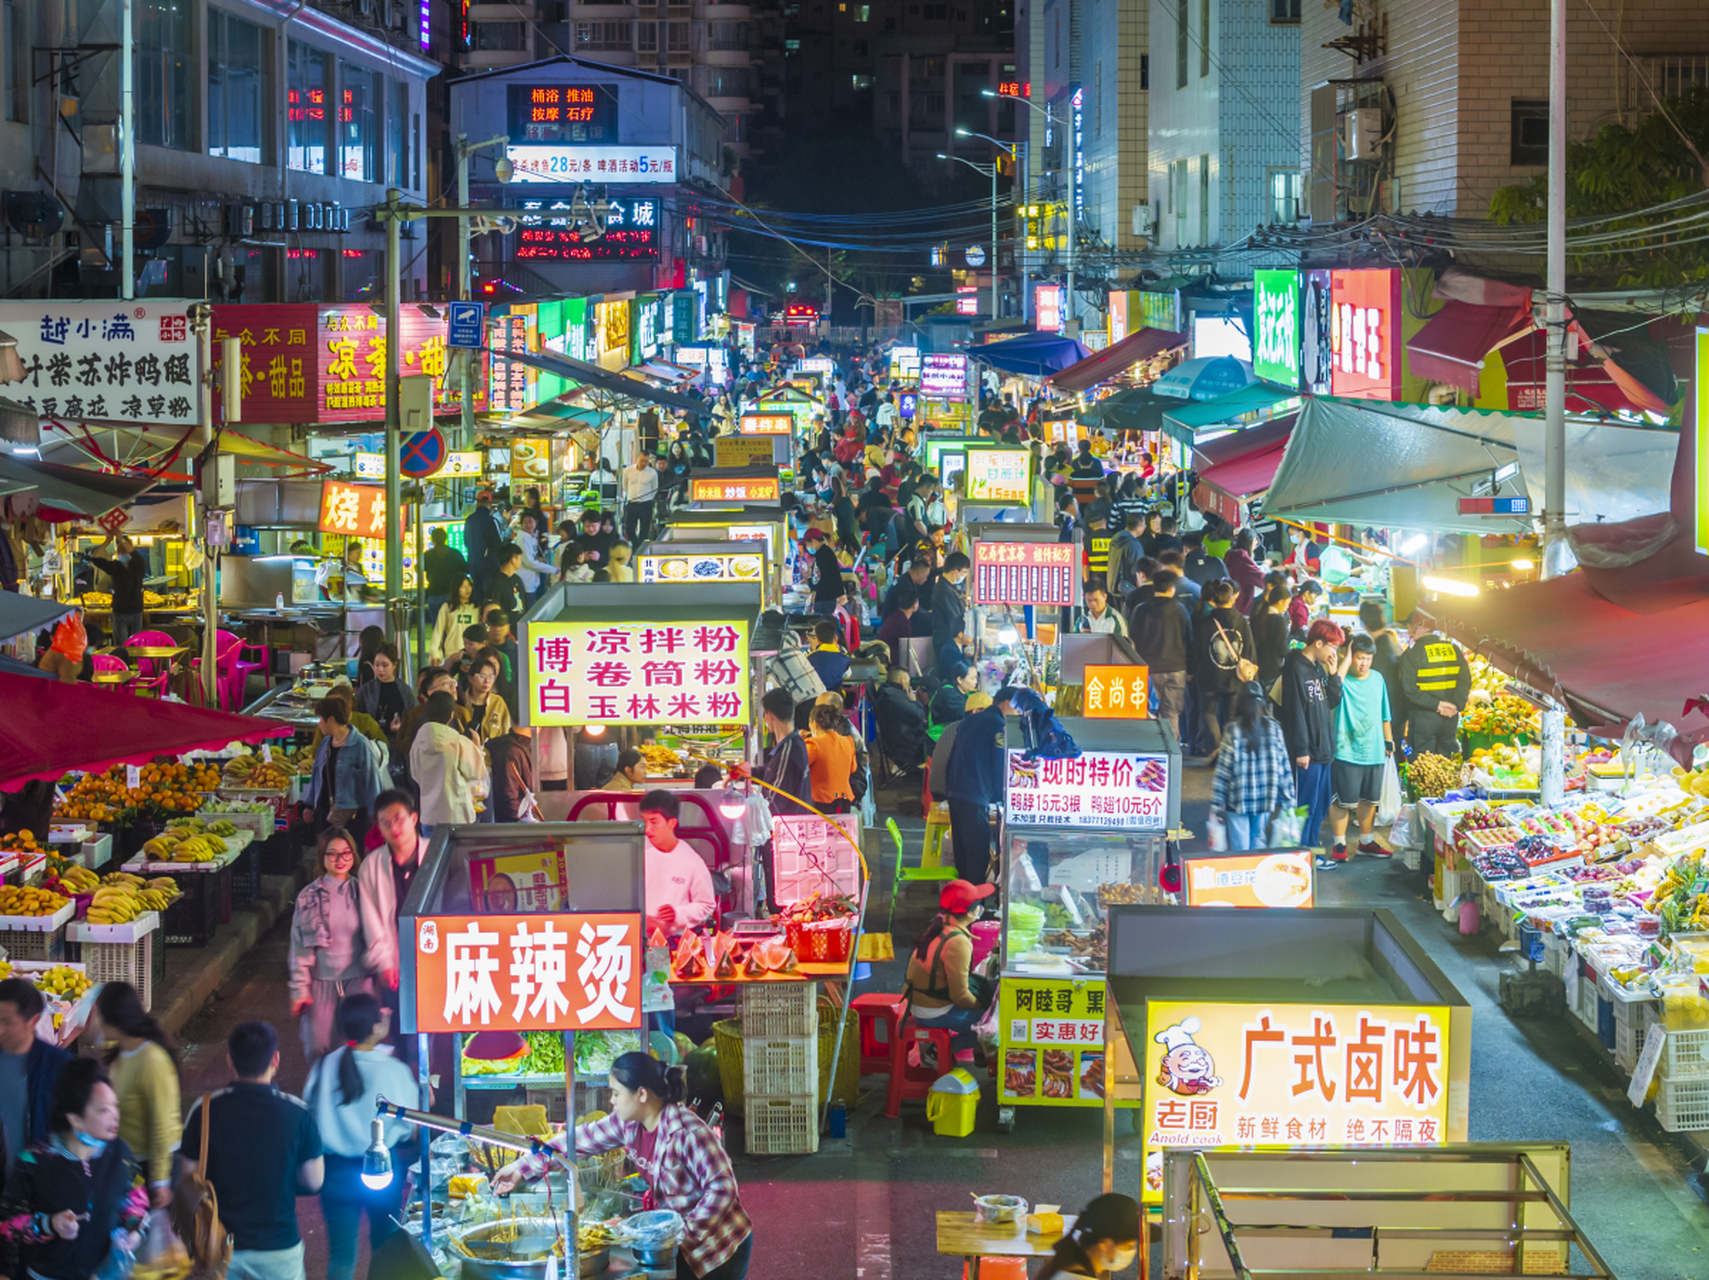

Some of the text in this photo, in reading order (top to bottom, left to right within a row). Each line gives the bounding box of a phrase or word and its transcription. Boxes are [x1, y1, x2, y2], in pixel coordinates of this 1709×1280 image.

[531, 88, 594, 103] 桶浴 推油
[531, 107, 594, 121] 按摩 石疗
[41, 314, 135, 345] 越小满
[326, 315, 378, 331] 与众不同
[212, 328, 306, 346] 与众不同
[120, 394, 192, 418] 凉草粉
[586, 626, 740, 655] 凉拌粉
[534, 637, 572, 714] 博白
[586, 659, 741, 687] 卷筒粉
[586, 692, 742, 719] 玉林米粉
[1087, 676, 1146, 709] 食尚串
[1042, 757, 1133, 787] 现时特价
[1011, 793, 1163, 816] 鸭脖15元3根 鸭翅10元5个
[443, 921, 635, 1025] 麻辣烫
[1036, 1022, 1104, 1041] 实惠好
[1238, 1016, 1438, 1105] 广式卤味
[1157, 1100, 1217, 1130] 老厨
[1237, 1116, 1437, 1143] 新鲜食材 绝不隔夜
